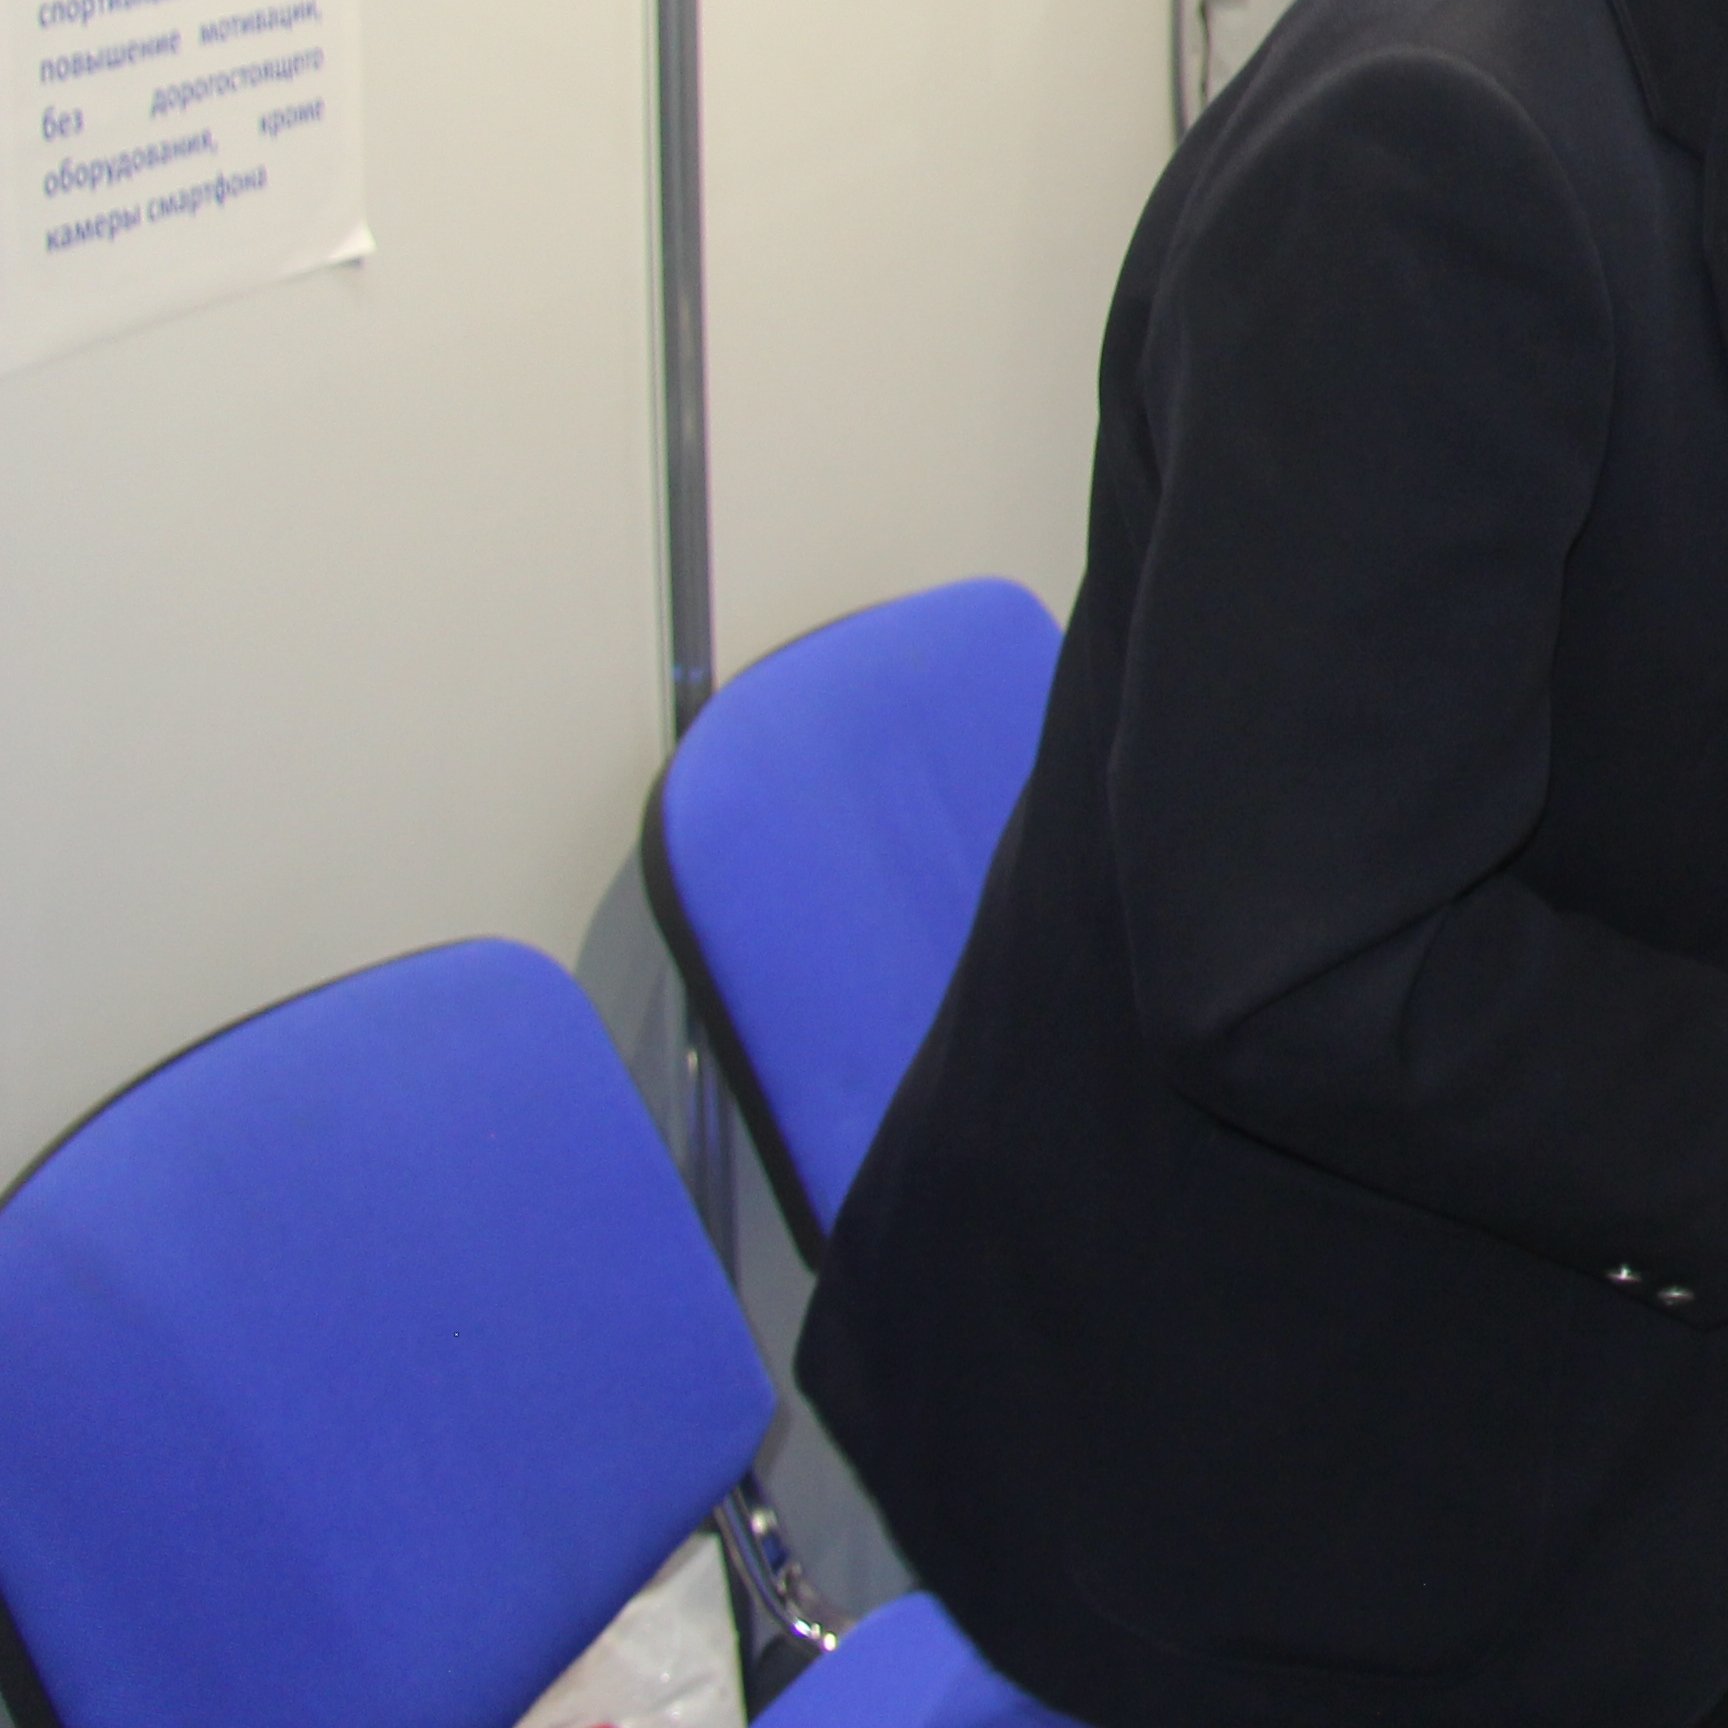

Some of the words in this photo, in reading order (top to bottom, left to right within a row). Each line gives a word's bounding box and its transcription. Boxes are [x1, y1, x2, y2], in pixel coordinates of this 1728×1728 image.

[39, 29, 182, 85] повышение
[41, 104, 85, 143] без
[257, 97, 327, 140] кроме
[44, 204, 142, 255] камеры
[145, 165, 269, 224] смартфона
